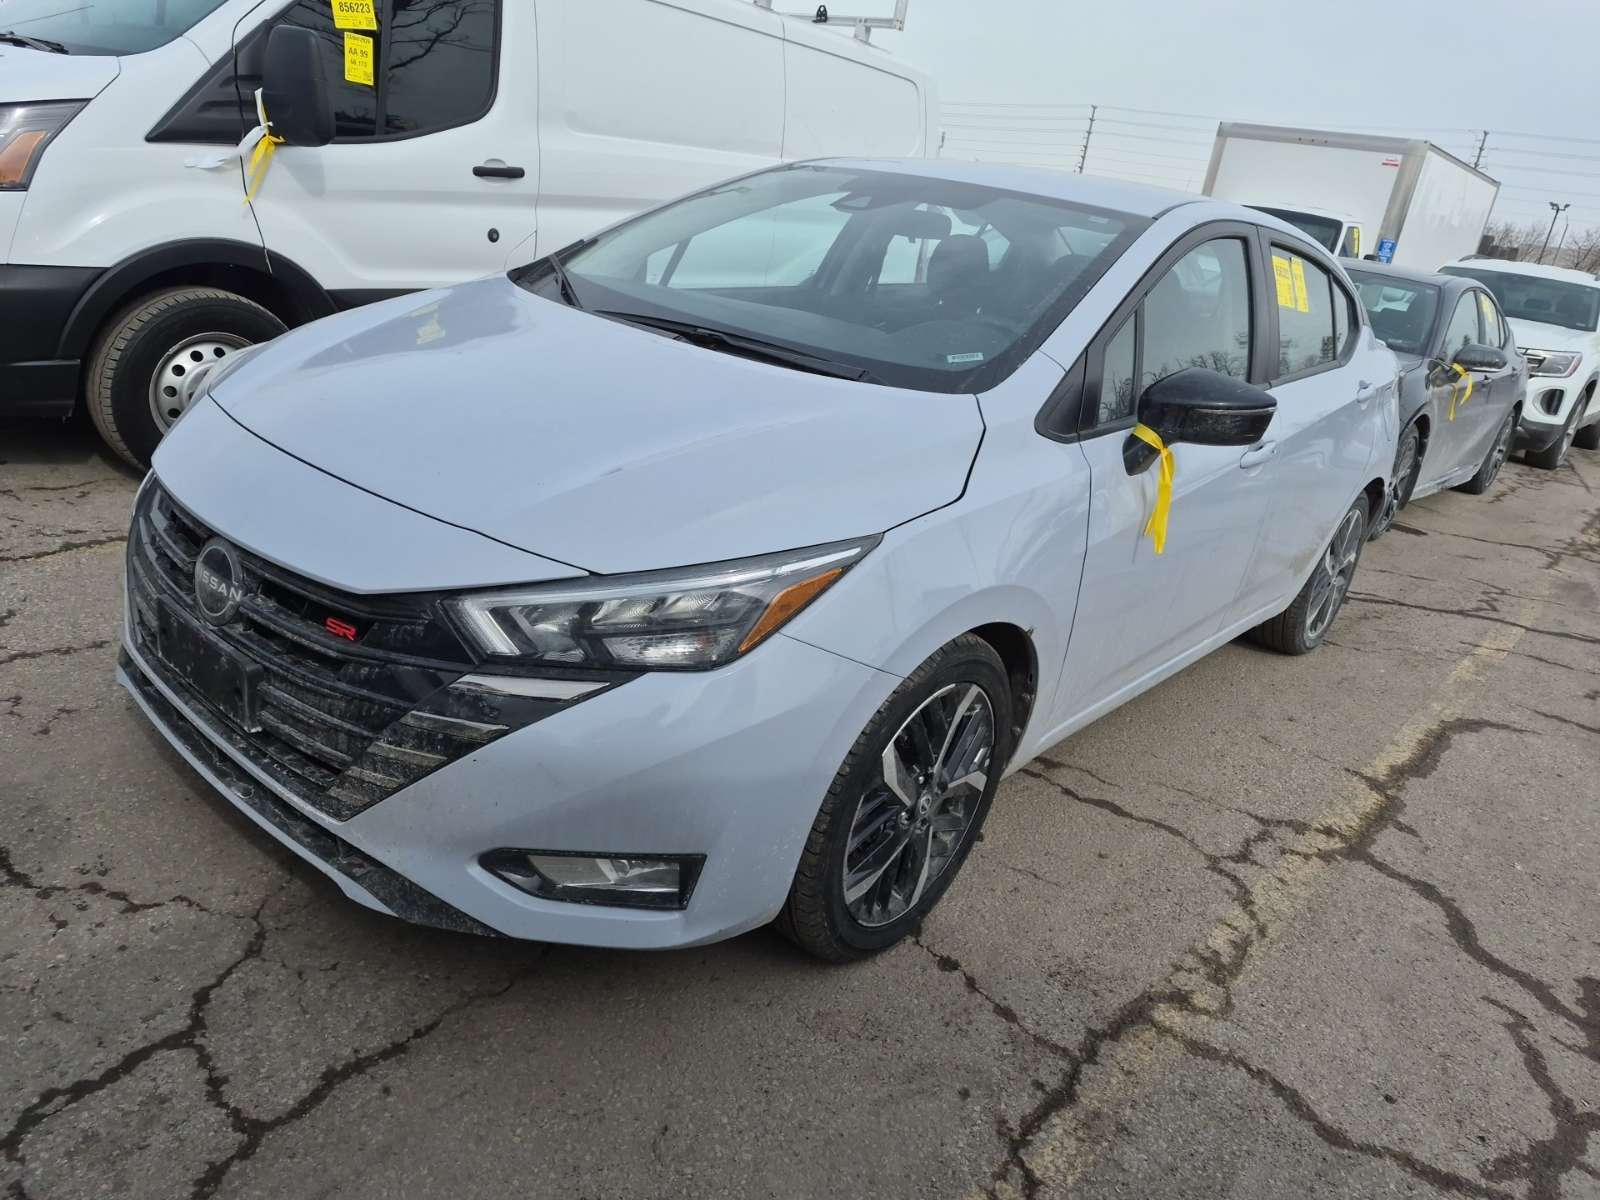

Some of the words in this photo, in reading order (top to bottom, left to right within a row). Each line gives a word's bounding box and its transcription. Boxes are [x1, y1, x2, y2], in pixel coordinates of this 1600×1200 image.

[338, 2, 371, 14] 856223
[198, 564, 244, 602] ISSAN
[325, 617, 356, 641] SR
